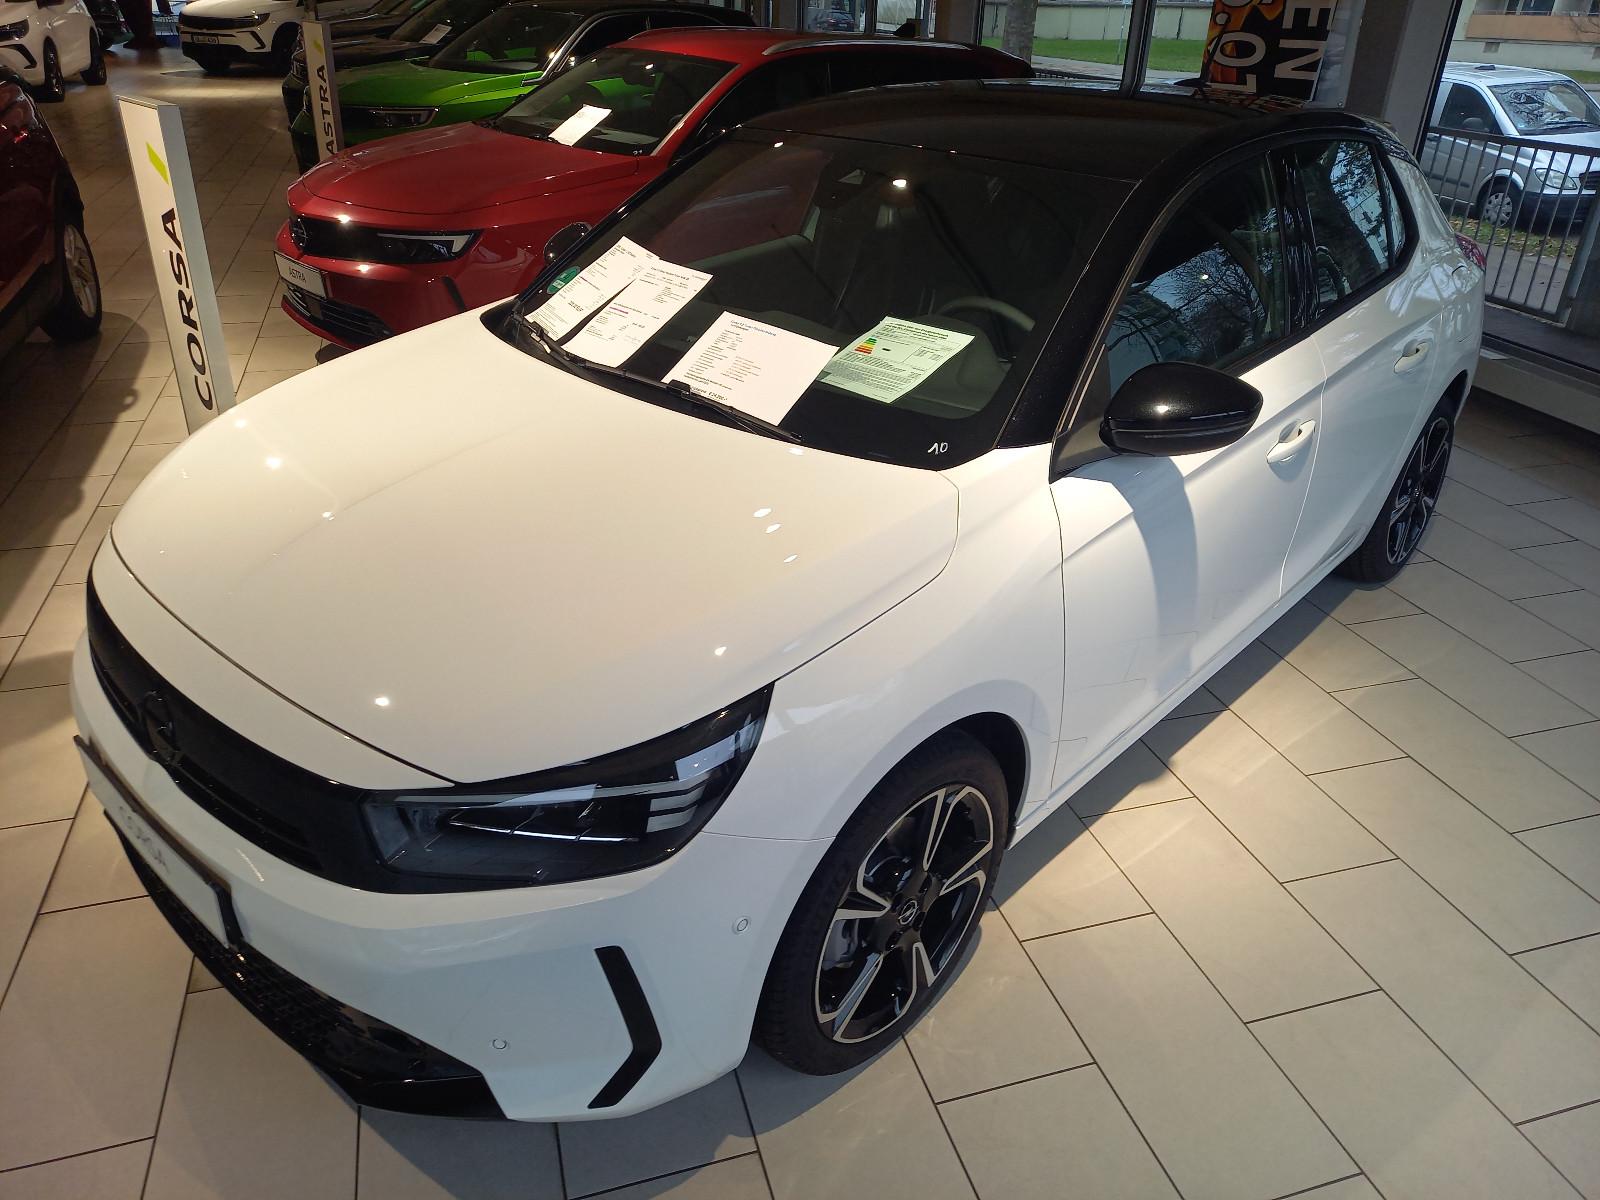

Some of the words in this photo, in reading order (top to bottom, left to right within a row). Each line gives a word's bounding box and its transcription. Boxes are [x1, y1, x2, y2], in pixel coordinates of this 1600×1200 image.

[315, 64, 335, 154] ASTRA
[288, 265, 307, 284] ASTRA
[161, 207, 213, 411] CORSA
[927, 442, 949, 455] 10
